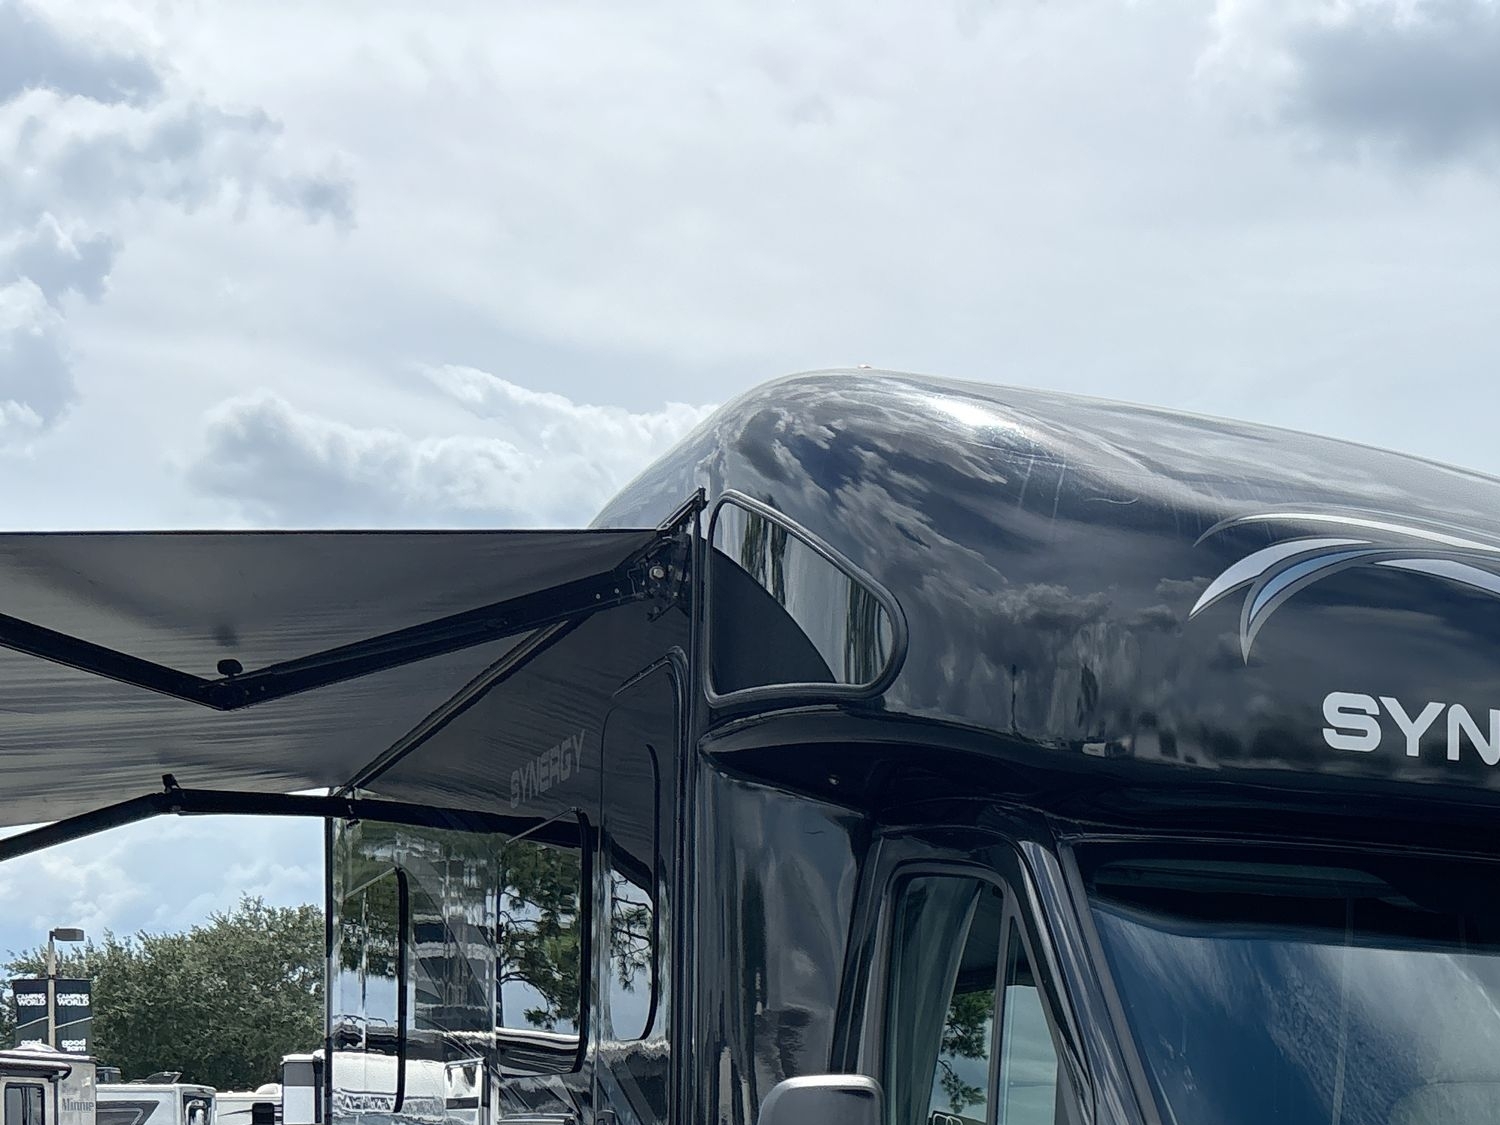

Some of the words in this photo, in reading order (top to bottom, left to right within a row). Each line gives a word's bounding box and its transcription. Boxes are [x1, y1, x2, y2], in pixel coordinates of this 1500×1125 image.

[510, 728, 586, 809] SYNERGY
[17, 999, 47, 1007] WORLD
[57, 999, 90, 1007] WORLD
[61, 1038, 87, 1048] good
